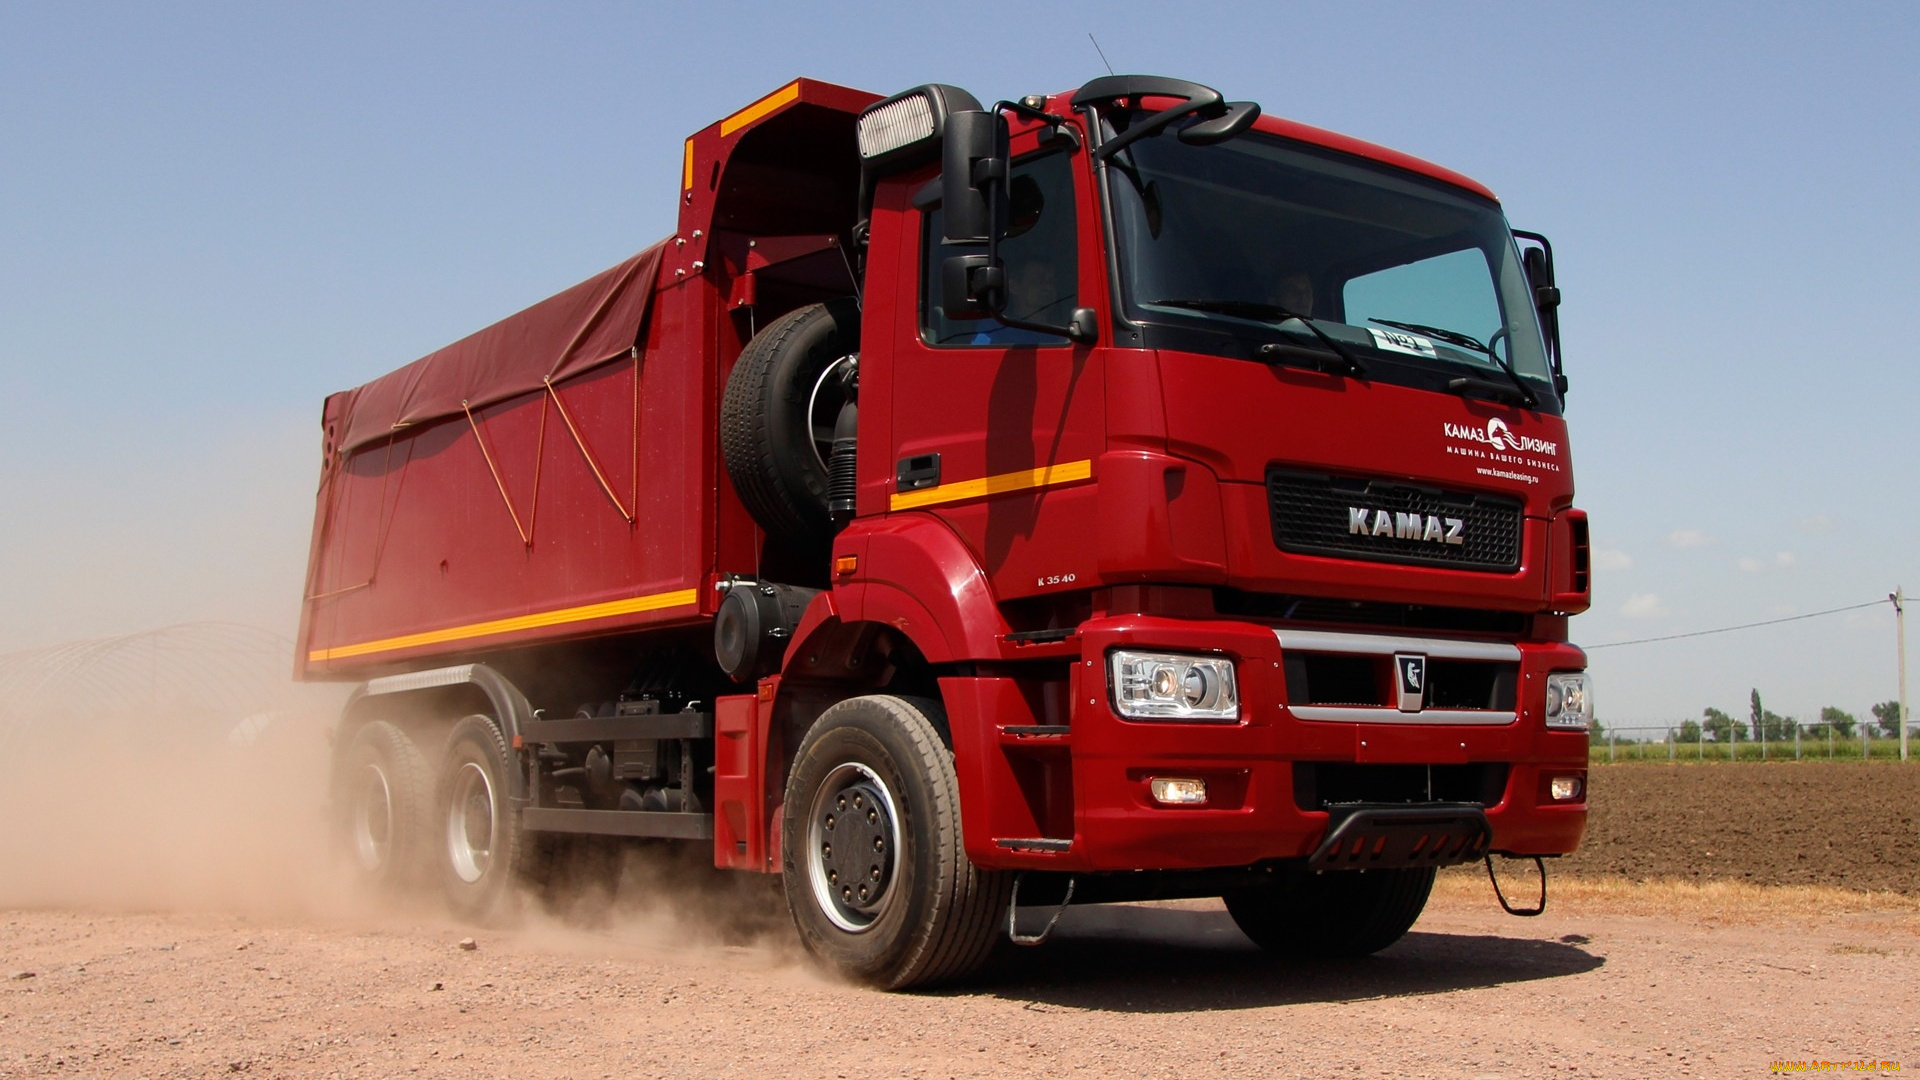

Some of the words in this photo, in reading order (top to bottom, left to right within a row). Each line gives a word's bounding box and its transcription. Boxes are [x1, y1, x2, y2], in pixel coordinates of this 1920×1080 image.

[1444, 422, 1485, 442] КАМАЗ
[1520, 436, 1557, 456] ЛИЗИНГ
[1446, 445, 1486, 458] МАШИНА
[1490, 452, 1523, 465] ВАШЕГО
[1527, 458, 1560, 472] БИЗНЕСА
[1476, 466, 1539, 484] www.kamazleasing.ru
[1349, 506, 1464, 545] KAMAZ
